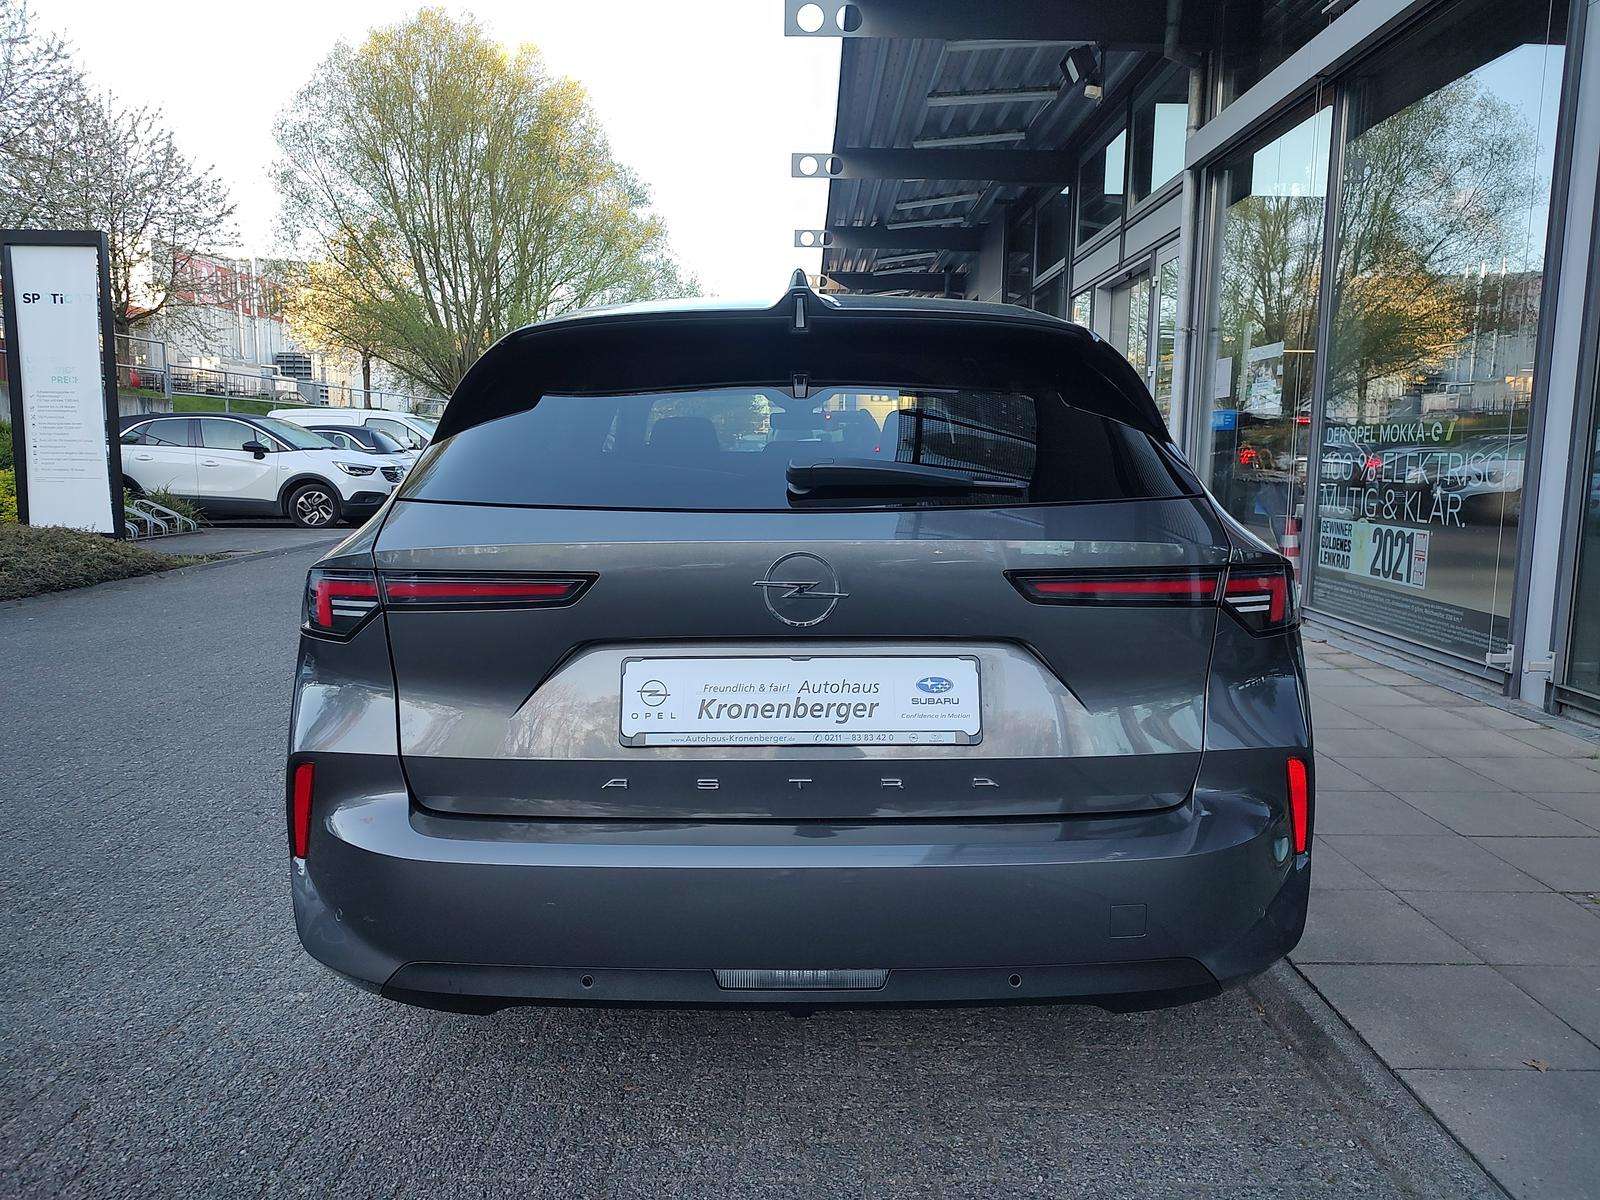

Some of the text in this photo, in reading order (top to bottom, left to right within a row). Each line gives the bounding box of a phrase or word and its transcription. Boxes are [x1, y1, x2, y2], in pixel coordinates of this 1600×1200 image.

[1326, 426, 1346, 443] DER
[1350, 425, 1376, 443] OPEL
[1323, 452, 1352, 480] 100
[1358, 453, 1377, 481] %
[1321, 484, 1466, 528] MUTIG & KLAR.
[1321, 520, 1353, 537] GEWINNER
[1320, 535, 1352, 552] GOLDENES
[1319, 550, 1350, 570] LENKRAD
[1370, 527, 1415, 583] 2021
[703, 679, 880, 694] Freundlich & fair! Autohaus
[631, 712, 676, 720] OPEL
[697, 697, 879, 724] Kronenberger
[824, 734, 842, 742] 0211
[851, 733, 861, 742] 83
[864, 733, 874, 742] 83
[876, 733, 886, 742] 42
[889, 733, 894, 742] 0
[601, 778, 1000, 790] ASTRA
